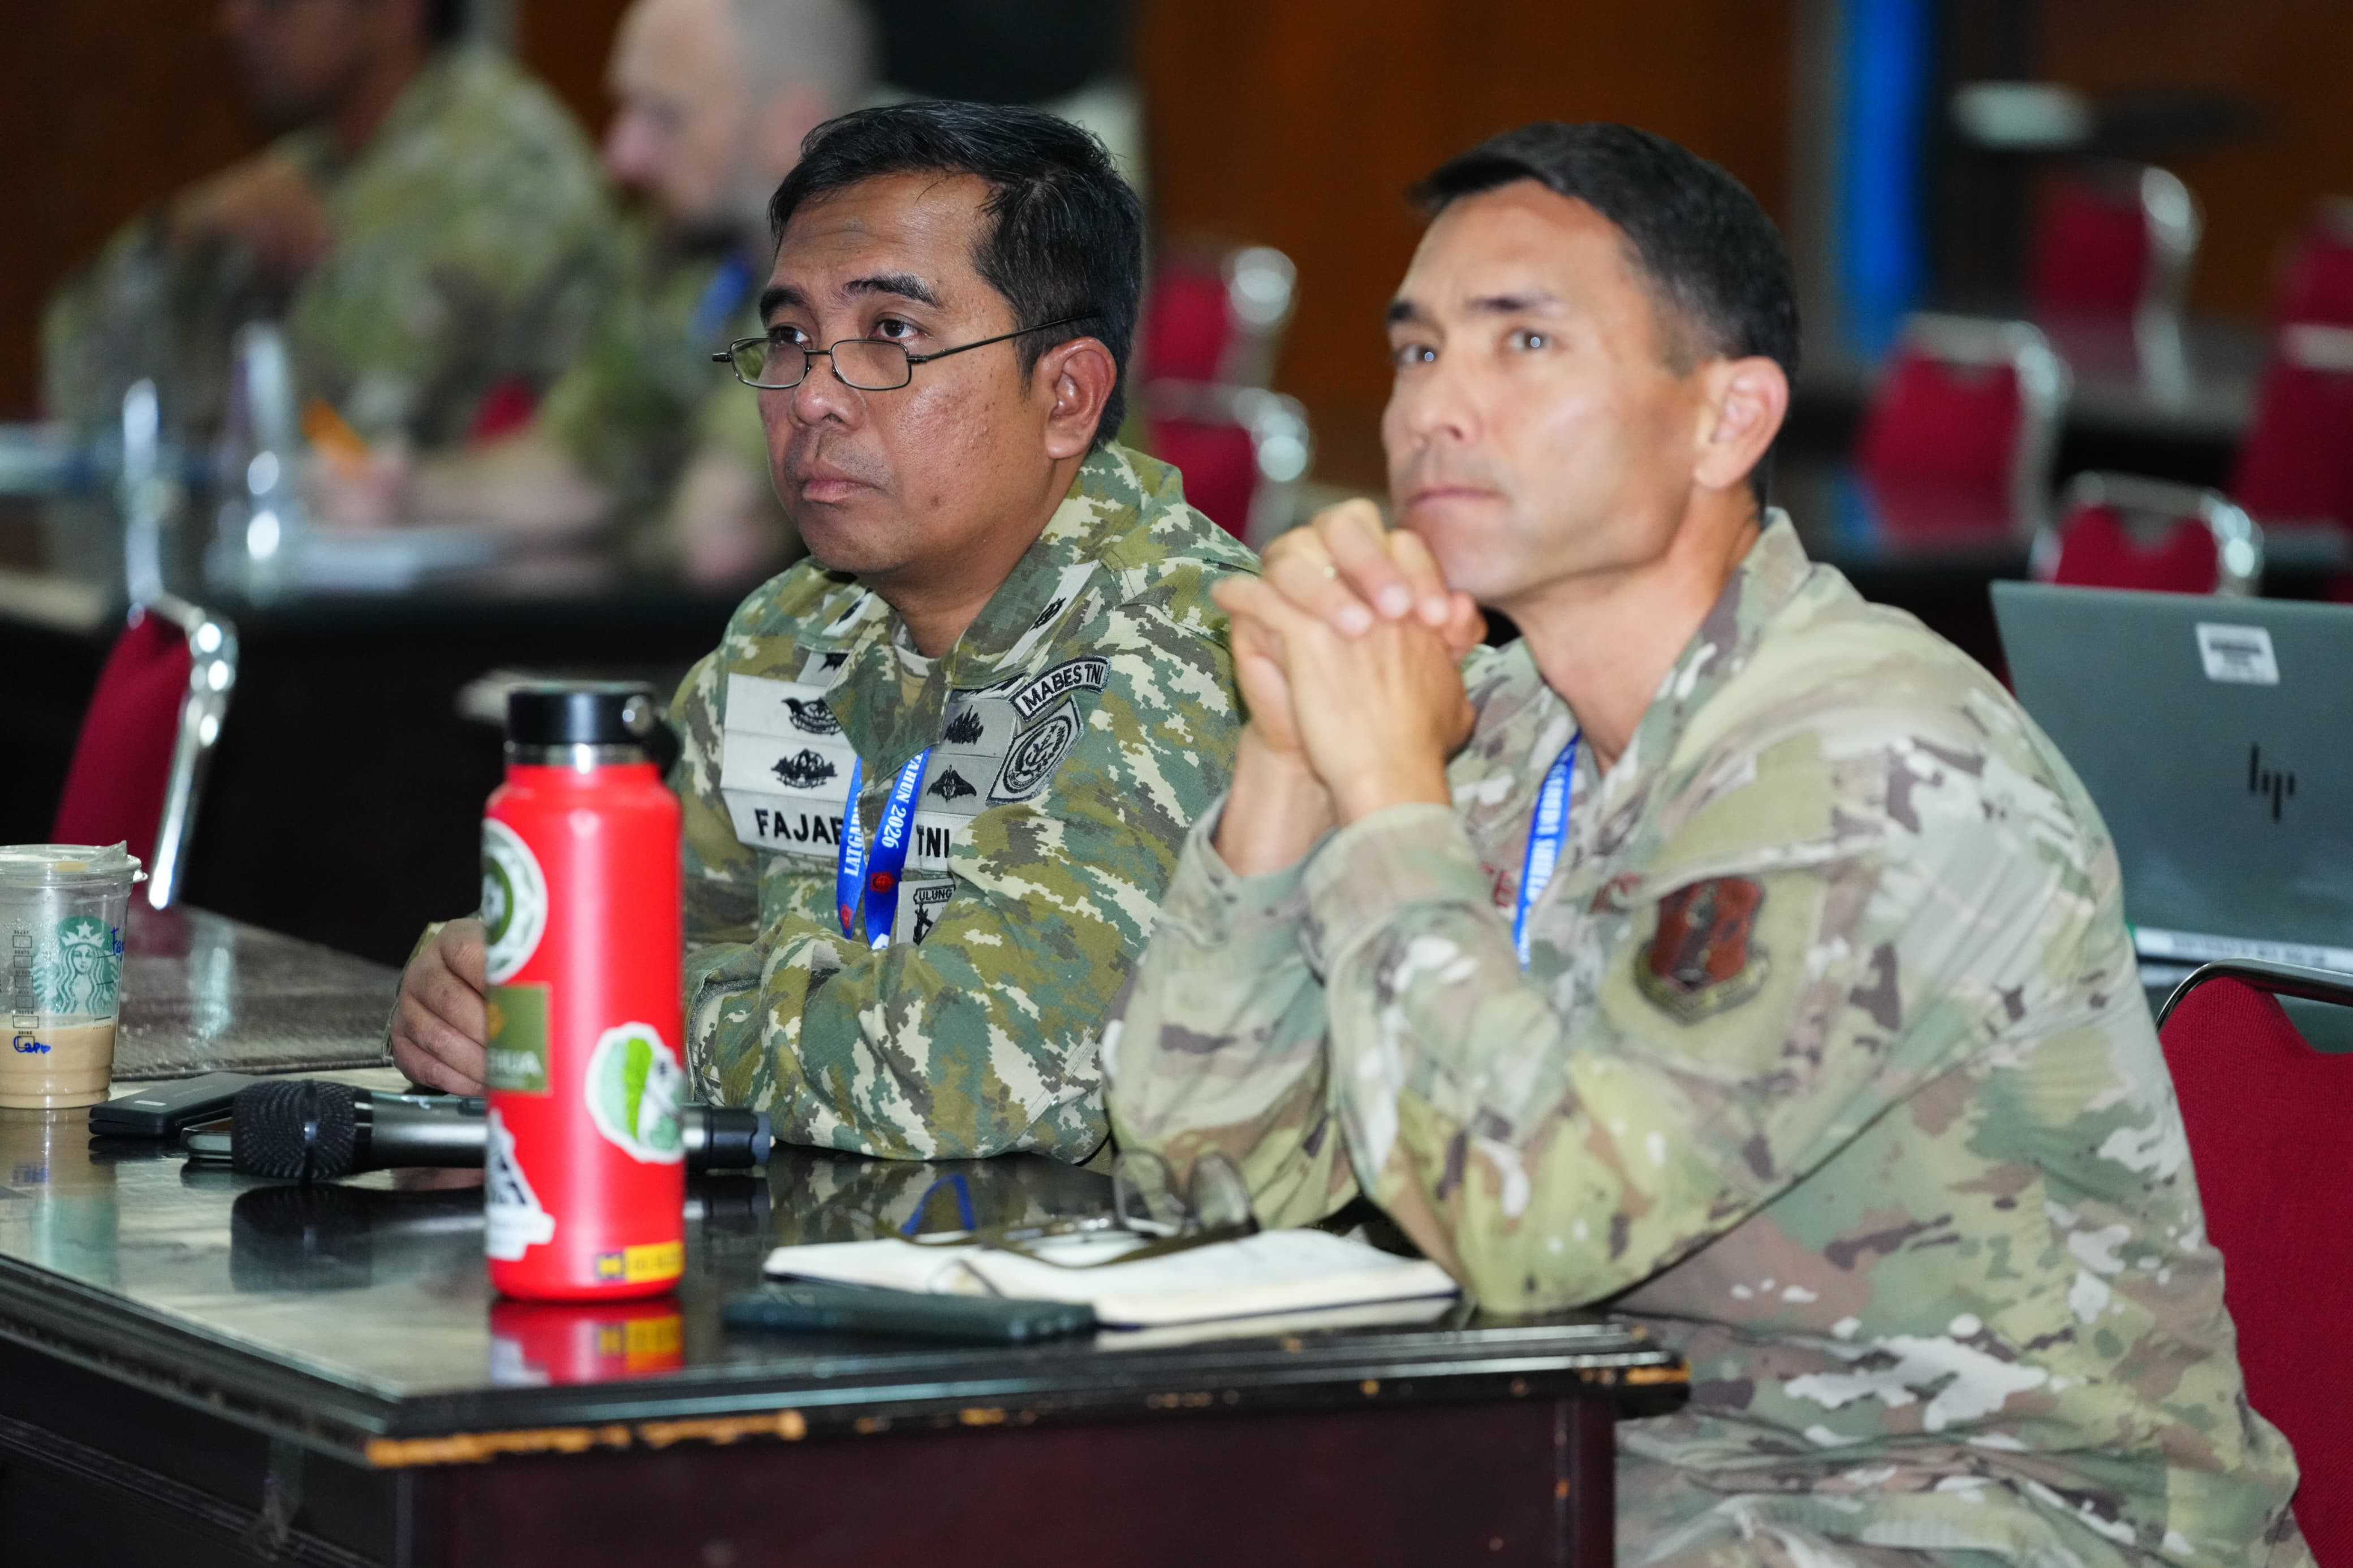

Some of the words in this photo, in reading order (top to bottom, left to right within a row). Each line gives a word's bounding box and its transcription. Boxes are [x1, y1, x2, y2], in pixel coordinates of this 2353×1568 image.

[1022, 664, 1081, 711] MABES
[1084, 663, 1104, 685] TNI
[896, 753, 924, 804] TAHUN
[882, 804, 907, 849] 2026
[916, 824, 950, 858] TNI
[919, 888, 953, 901] ULUNG
